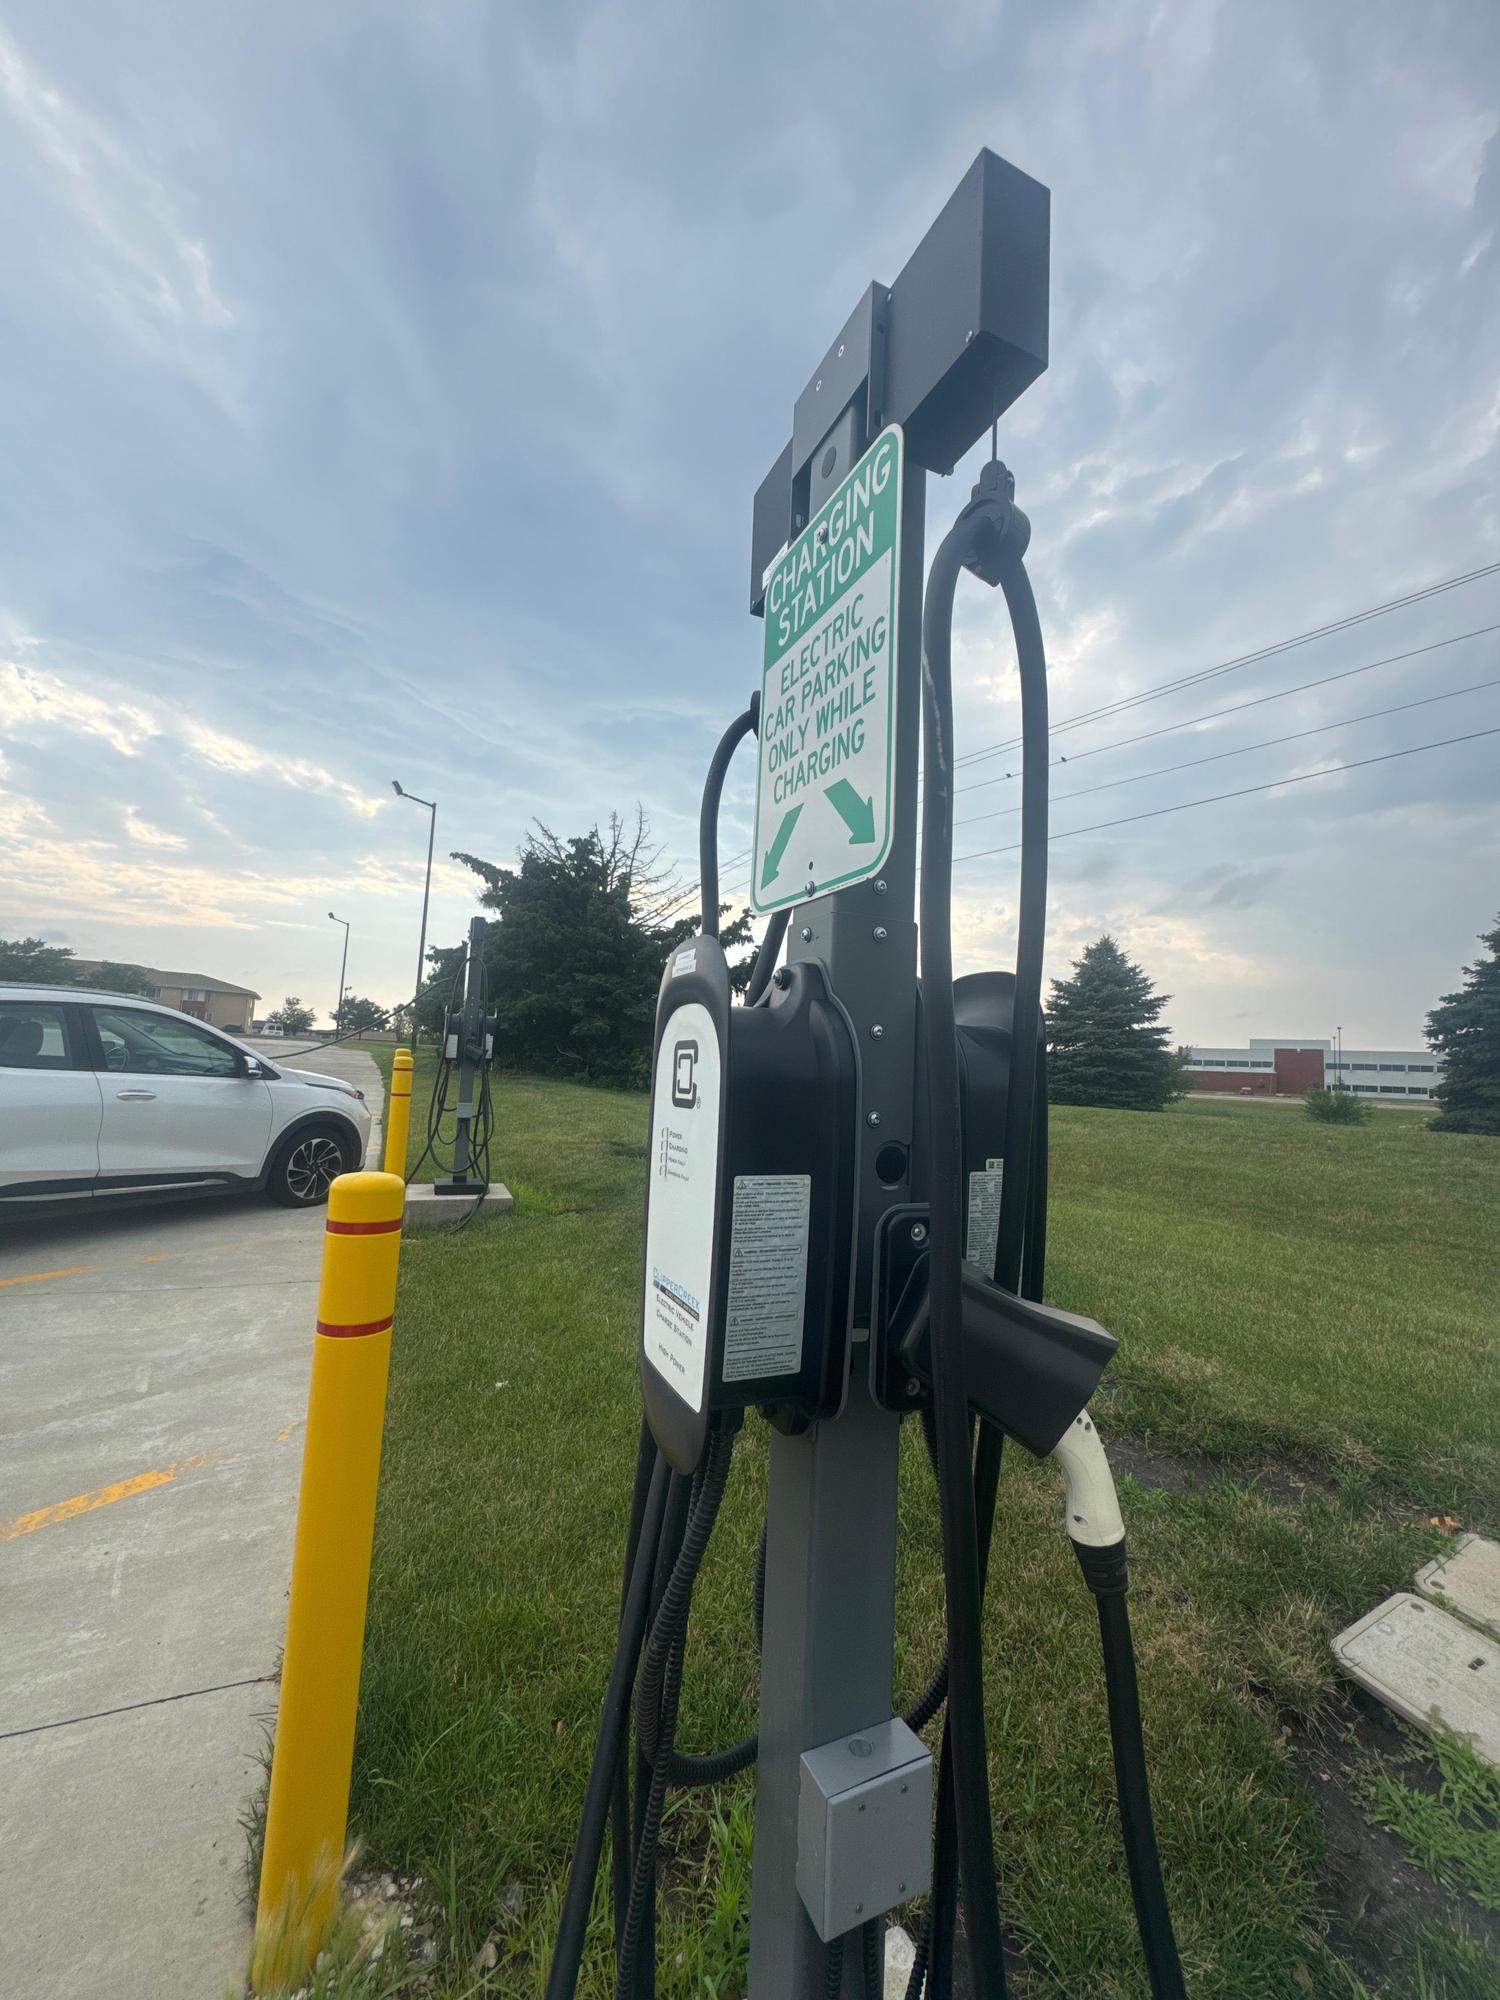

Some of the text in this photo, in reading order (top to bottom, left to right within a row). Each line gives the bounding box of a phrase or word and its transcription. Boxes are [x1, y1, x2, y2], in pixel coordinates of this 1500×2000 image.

[771, 443, 892, 614] CHARGING
[777, 510, 874, 647] STATION
[765, 615, 886, 742] CAR PARKING
[781, 593, 864, 696] ELECTRIC
[768, 665, 876, 773] ONLY WHILE
[774, 718, 865, 805] CHARGING
